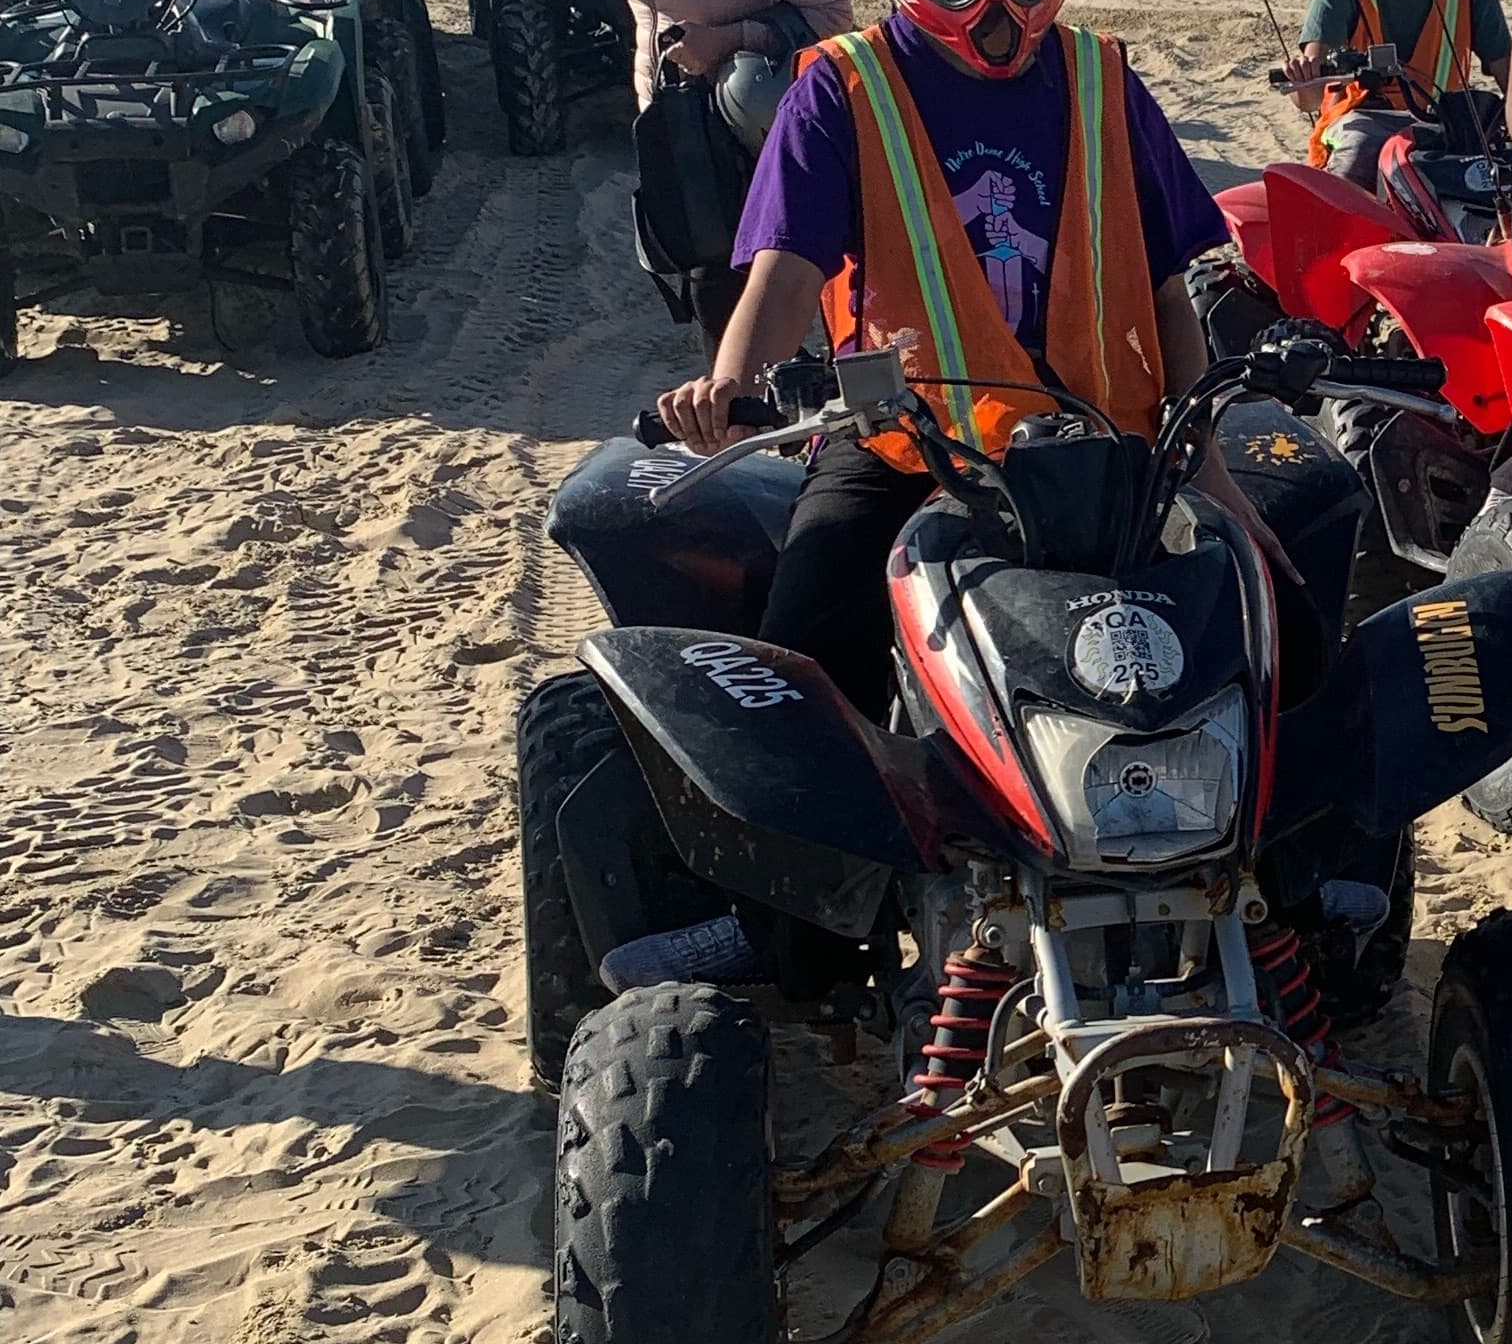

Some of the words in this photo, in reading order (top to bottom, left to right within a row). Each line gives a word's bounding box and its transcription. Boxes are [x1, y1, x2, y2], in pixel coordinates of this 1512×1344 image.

[944, 149, 974, 172] Notre
[1004, 147, 1032, 169] High
[1028, 170, 1051, 206] School
[1065, 589, 1177, 611] HONDA
[1105, 611, 1148, 629] QA
[679, 641, 805, 708] QA225
[1412, 600, 1489, 734] SUNBUGGY
